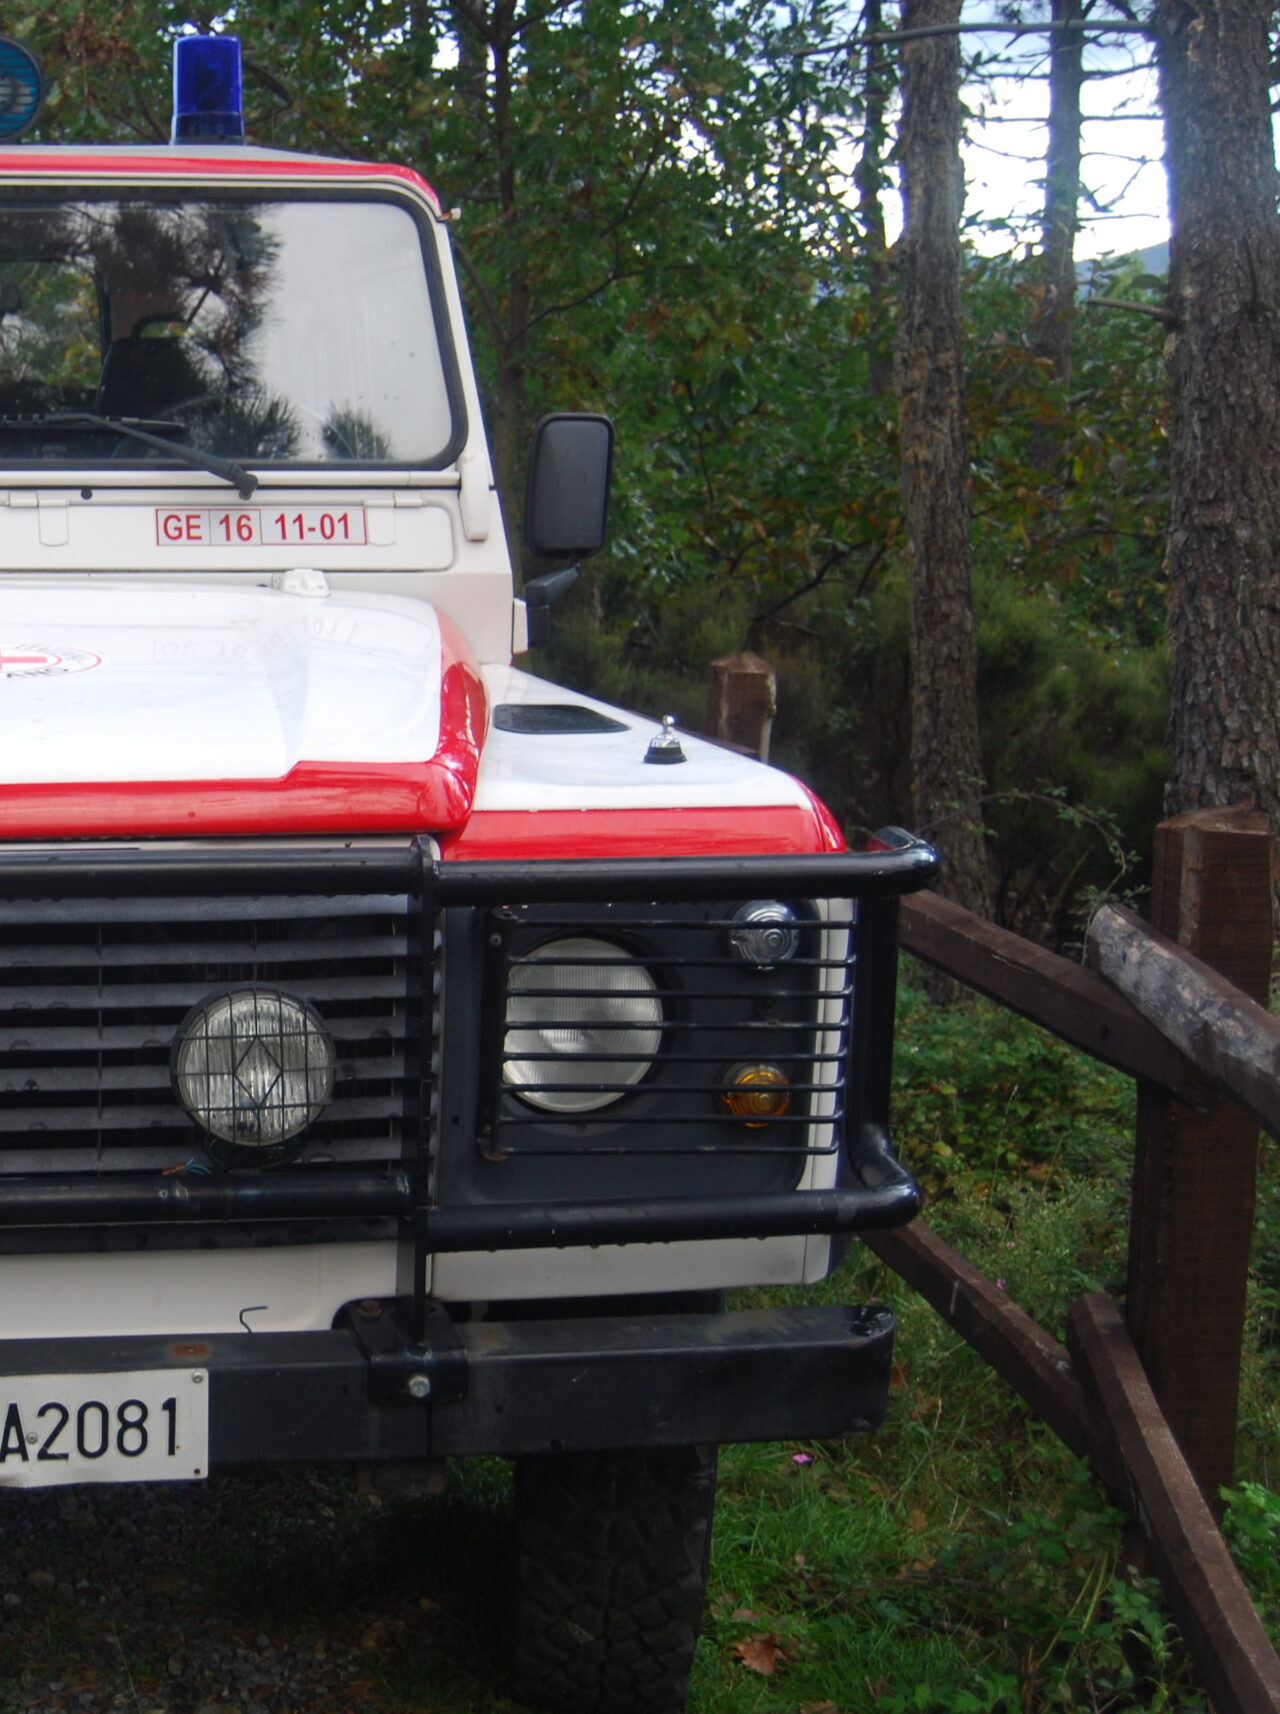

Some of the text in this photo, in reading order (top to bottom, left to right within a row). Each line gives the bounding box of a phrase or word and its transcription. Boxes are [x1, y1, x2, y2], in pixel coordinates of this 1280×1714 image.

[163, 513, 349, 541] GE 16 11-01
